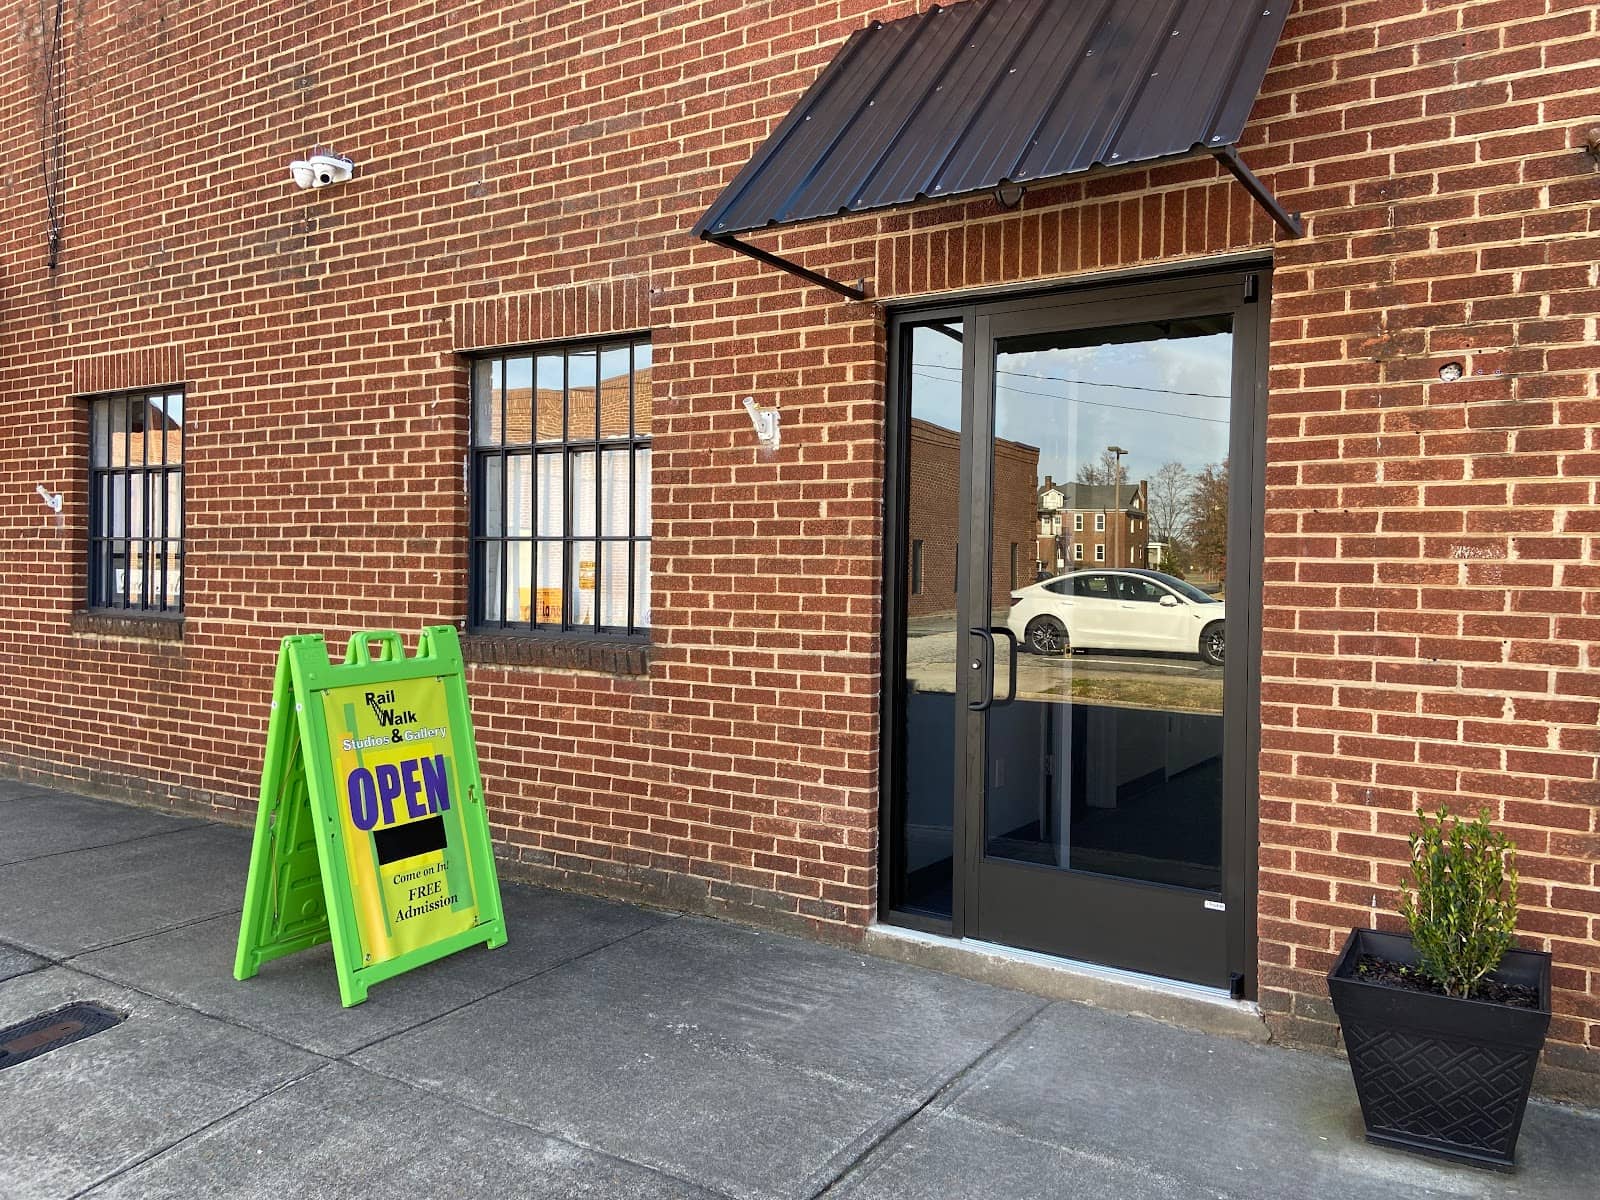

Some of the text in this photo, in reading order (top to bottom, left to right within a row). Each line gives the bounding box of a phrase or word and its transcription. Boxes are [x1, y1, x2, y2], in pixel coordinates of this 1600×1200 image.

[365, 690, 395, 706] Rail
[379, 709, 418, 727] Walk
[343, 727, 446, 751] Studios & Gallery
[348, 754, 451, 831] OPEN
[393, 860, 449, 885] Come on In!
[408, 880, 442, 901] FREE
[395, 894, 458, 923] Admission
